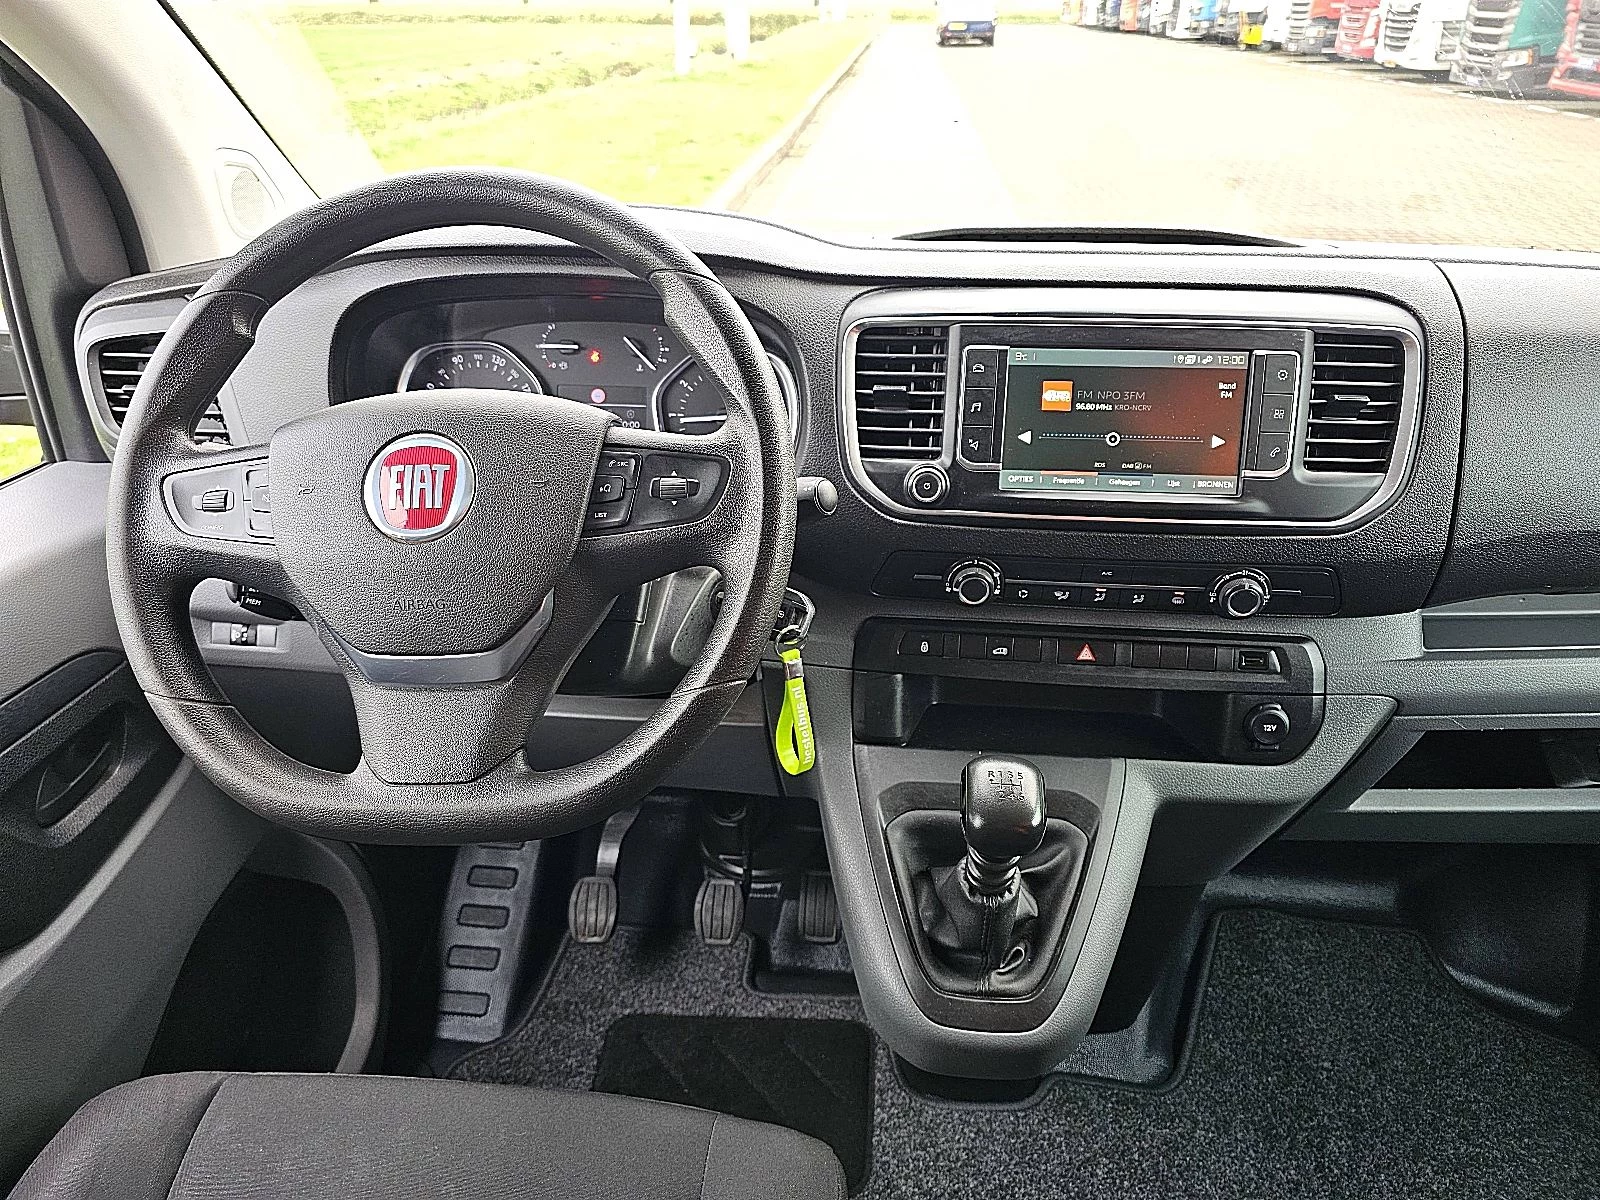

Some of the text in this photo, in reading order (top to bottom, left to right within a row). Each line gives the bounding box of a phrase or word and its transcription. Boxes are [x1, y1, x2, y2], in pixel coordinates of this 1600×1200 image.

[451, 354, 464, 365] 90
[491, 354, 507, 367] 130
[1217, 355, 1245, 365] 12:00
[679, 379, 689, 388] 2
[1218, 382, 1237, 390] Band
[1077, 390, 1093, 399] FM
[1097, 391, 1121, 400] NPO
[1123, 391, 1146, 401] 3FM
[1220, 391, 1233, 399] FM
[1075, 403, 1152, 412] 96.80 MHz KRO-NCRV
[1007, 475, 1034, 483] OPTIES
[388, 464, 451, 511] FIAT
[1197, 480, 1234, 489] BRONNEN
[245, 597, 262, 606] MEM
[392, 599, 446, 610] AIRBAG
[1263, 724, 1278, 732] 12V
[1017, 771, 1024, 780] 5
